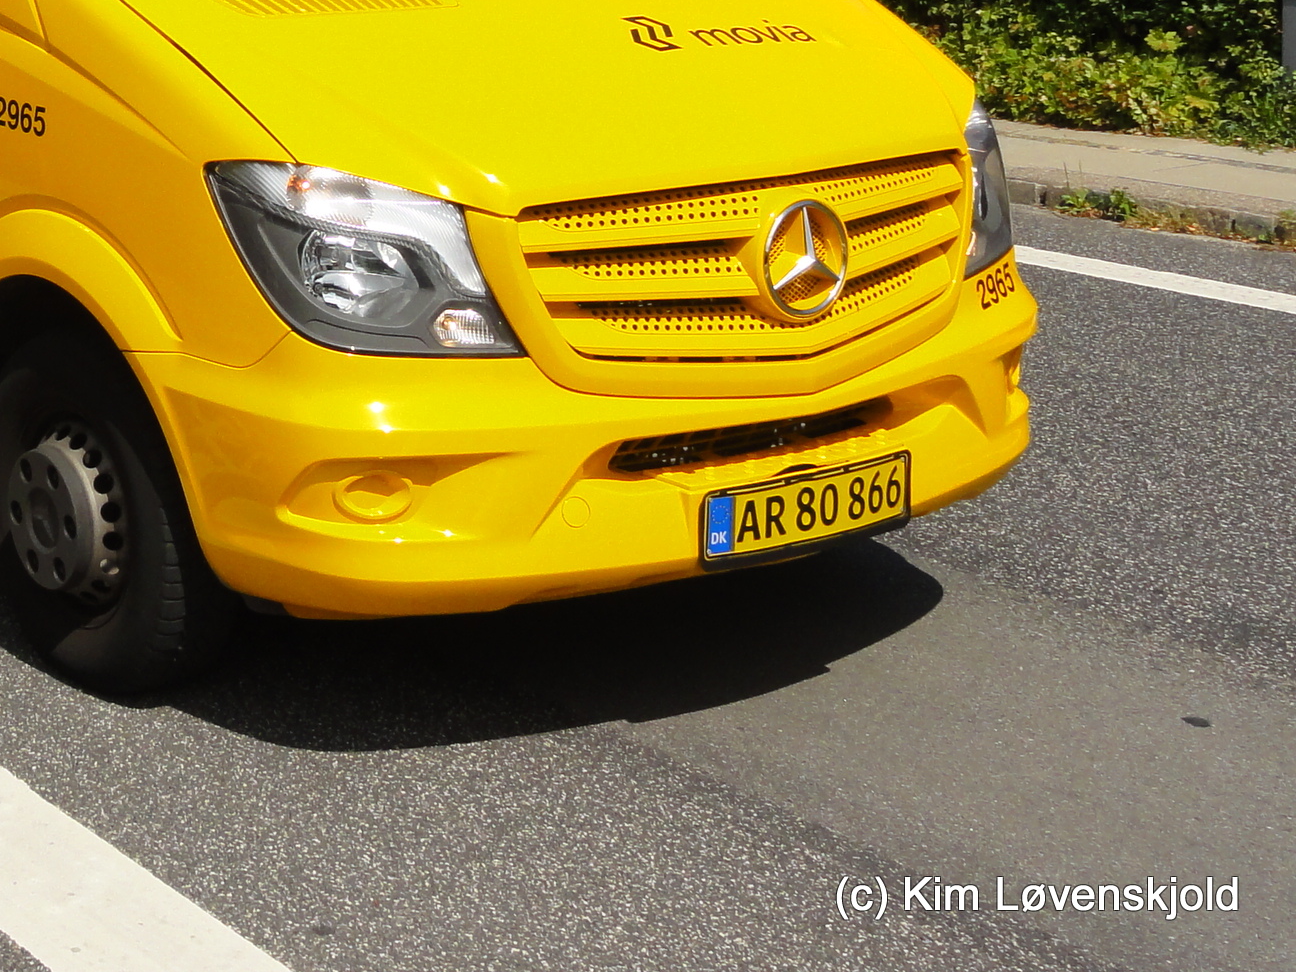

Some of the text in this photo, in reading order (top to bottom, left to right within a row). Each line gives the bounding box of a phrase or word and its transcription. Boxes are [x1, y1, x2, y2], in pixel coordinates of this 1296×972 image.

[688, 19, 817, 47] movia
[976, 261, 1015, 311] 2965
[736, 465, 901, 543] AR 80 866
[710, 530, 727, 545] DK
